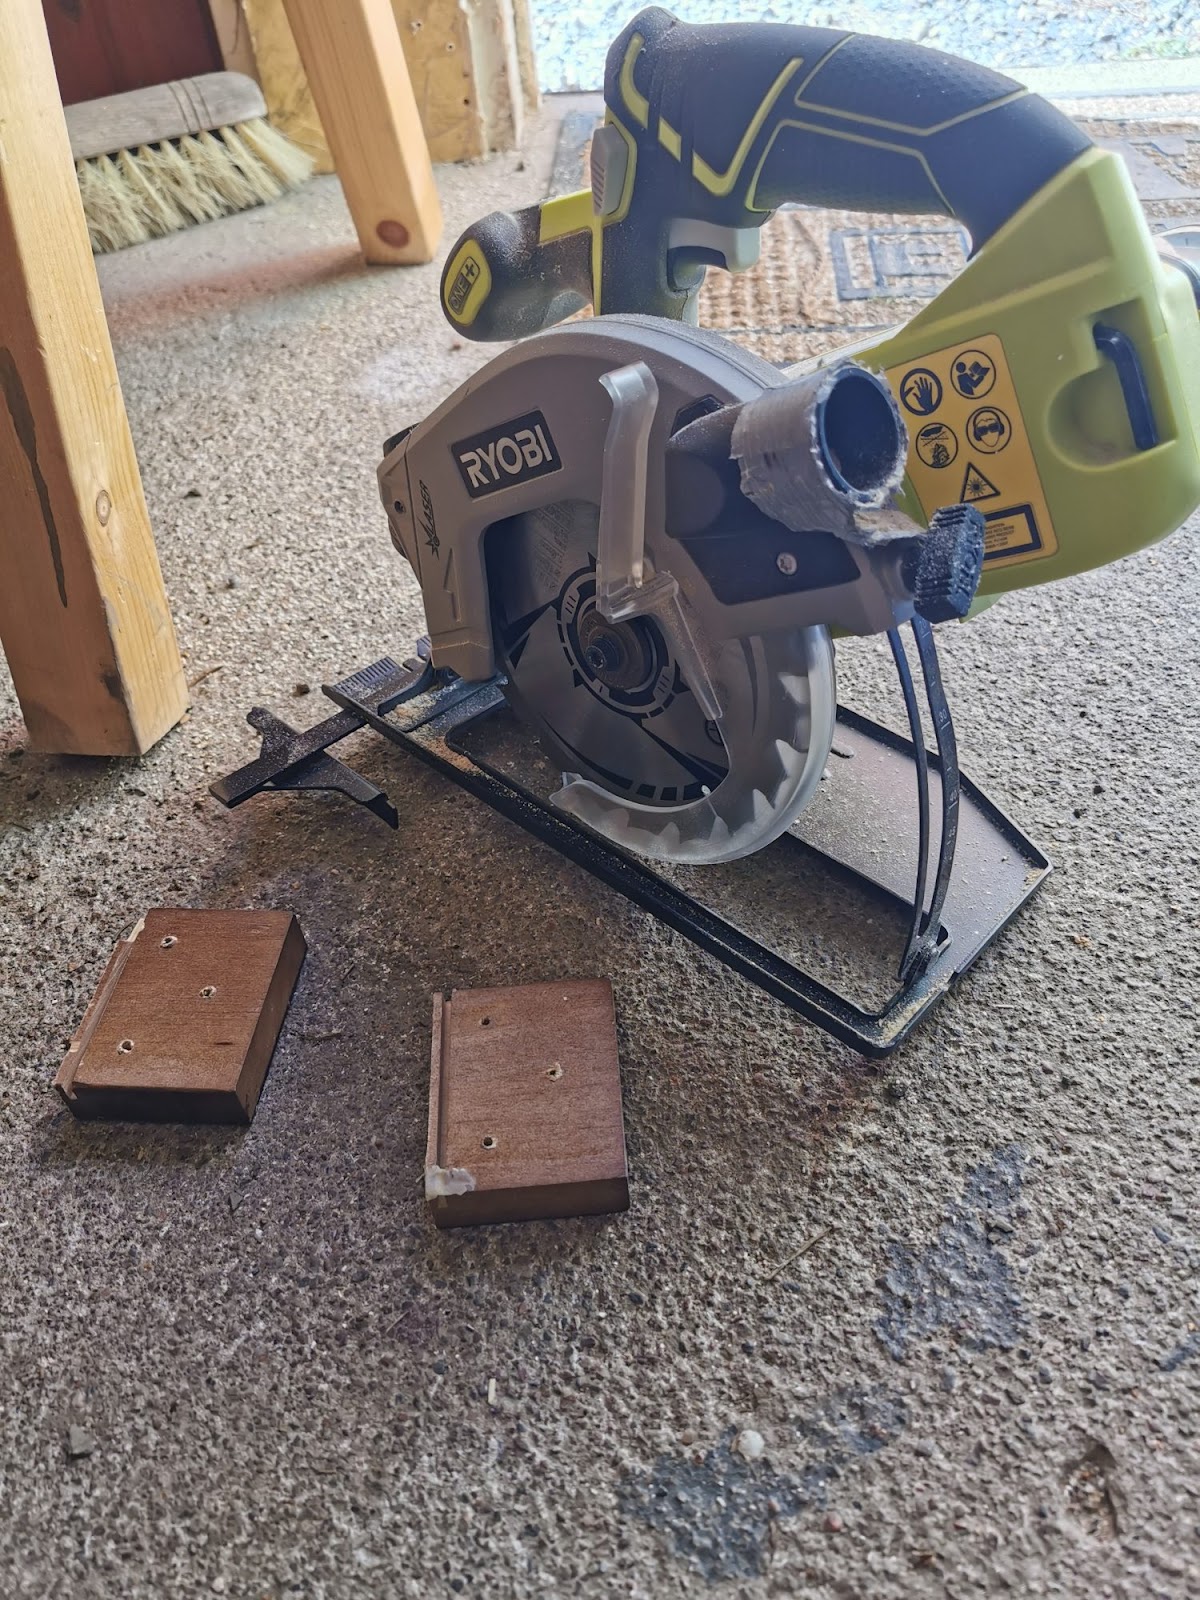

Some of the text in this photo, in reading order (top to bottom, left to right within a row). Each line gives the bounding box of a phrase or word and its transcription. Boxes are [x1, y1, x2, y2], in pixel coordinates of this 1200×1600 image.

[459, 424, 553, 488] RYOBI
[418, 479, 438, 541] LASER
[938, 708, 948, 723] 30
